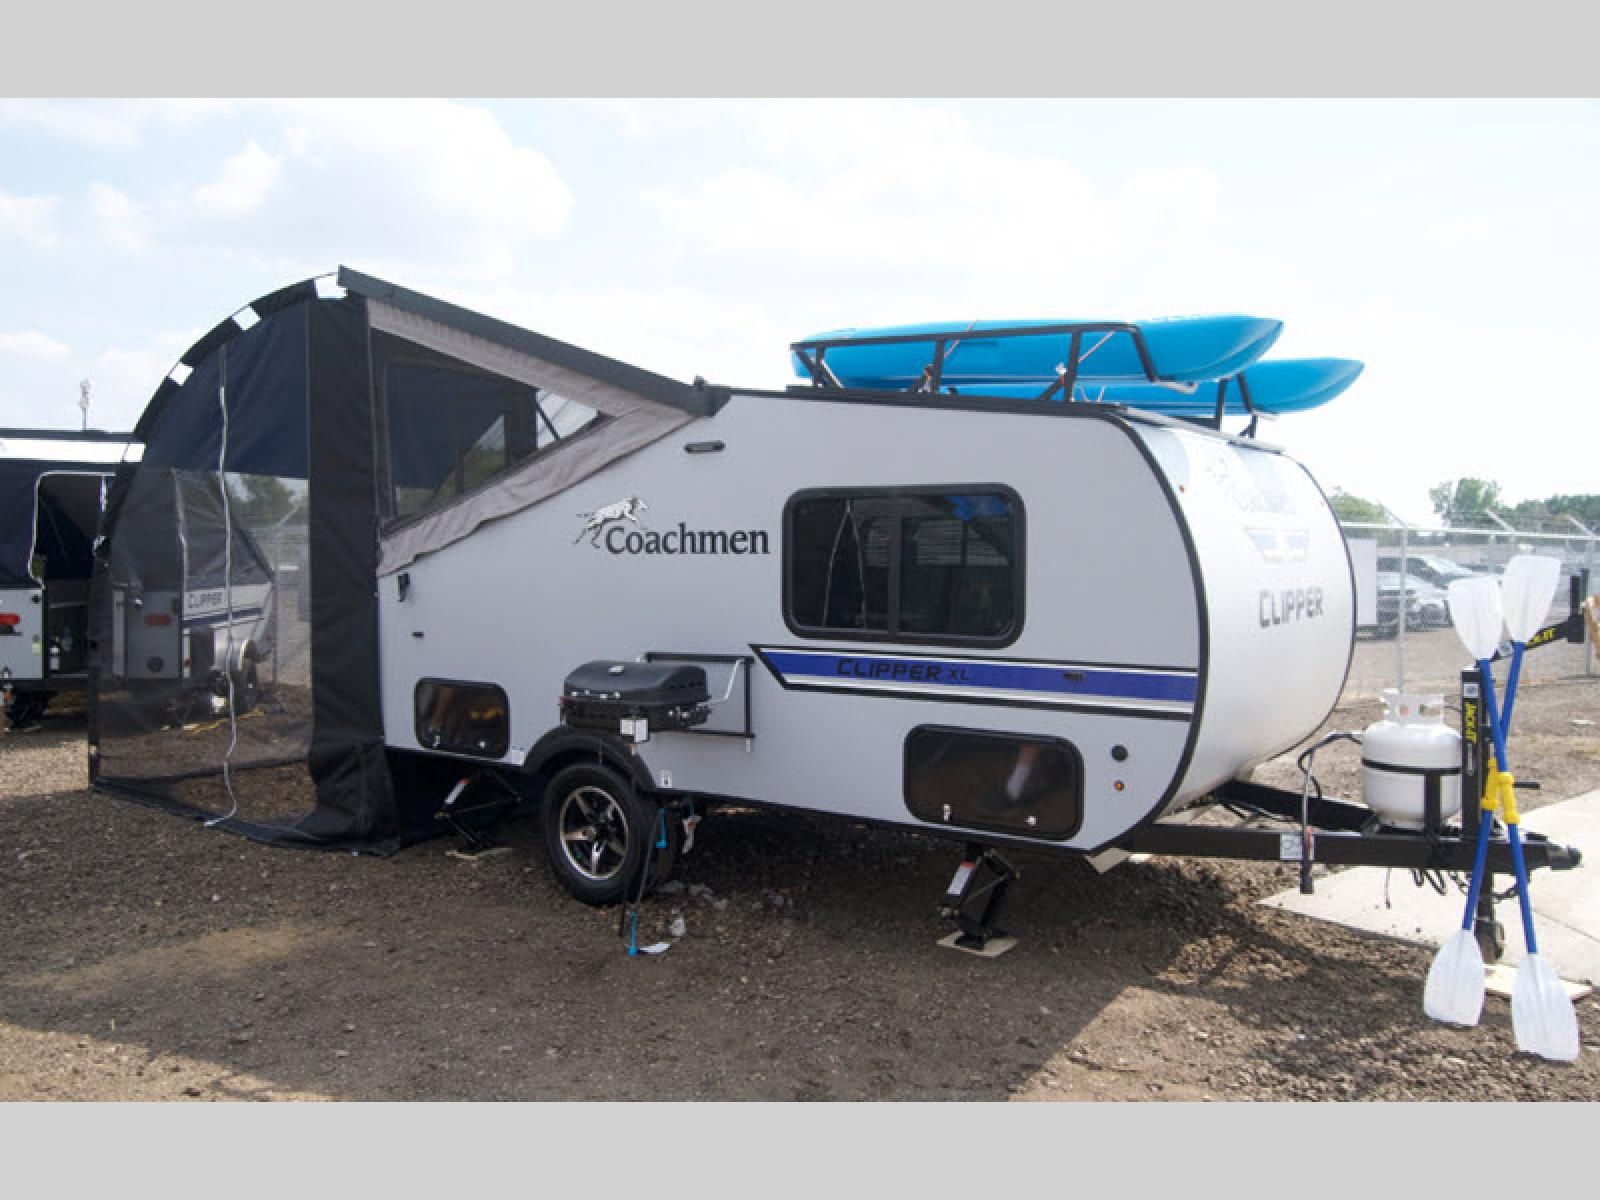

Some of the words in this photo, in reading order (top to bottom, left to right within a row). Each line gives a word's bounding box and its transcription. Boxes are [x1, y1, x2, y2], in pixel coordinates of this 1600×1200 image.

[605, 522, 770, 554] Coachmen
[1259, 586, 1324, 629] CLIPPER
[836, 657, 943, 682] CLIPPER
[946, 668, 973, 681] XL
